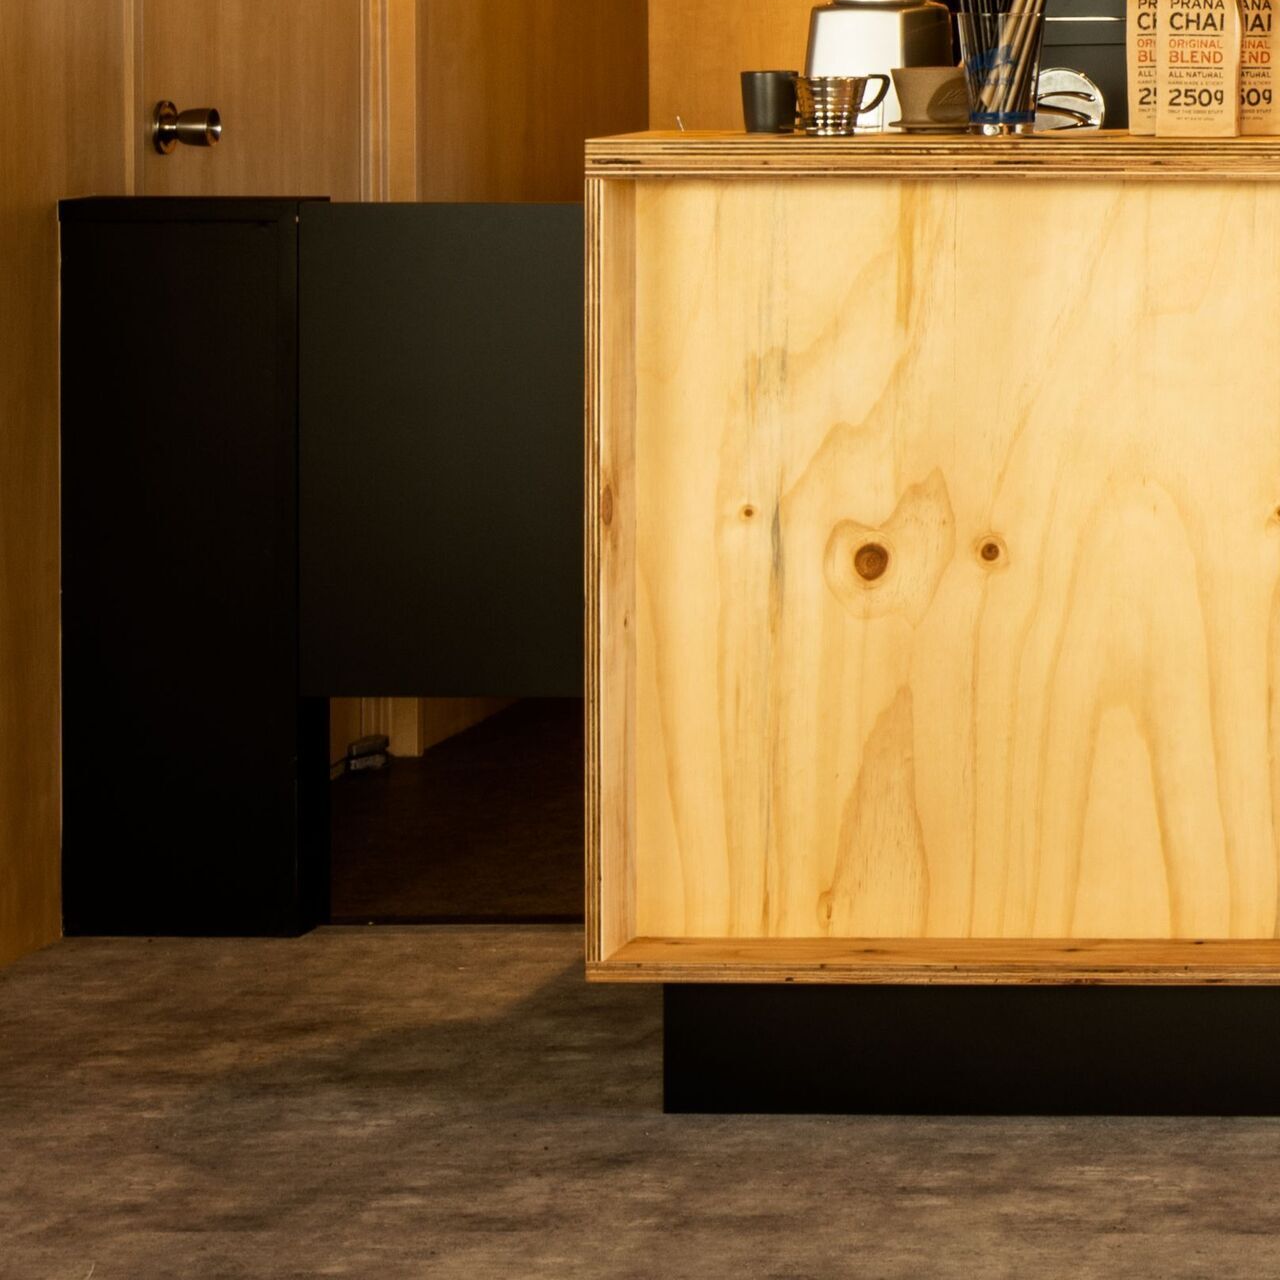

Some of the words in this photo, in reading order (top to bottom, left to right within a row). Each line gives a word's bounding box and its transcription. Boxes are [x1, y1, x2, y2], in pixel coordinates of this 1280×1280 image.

[1169, 12, 1224, 31] CHAI
[1168, 38, 1224, 49] ORIGINAL
[1169, 50, 1223, 64] BLEND
[1168, 71, 1184, 79] ALL
[1186, 71, 1224, 79] NATURAL
[1168, 88, 1224, 107] 250g
